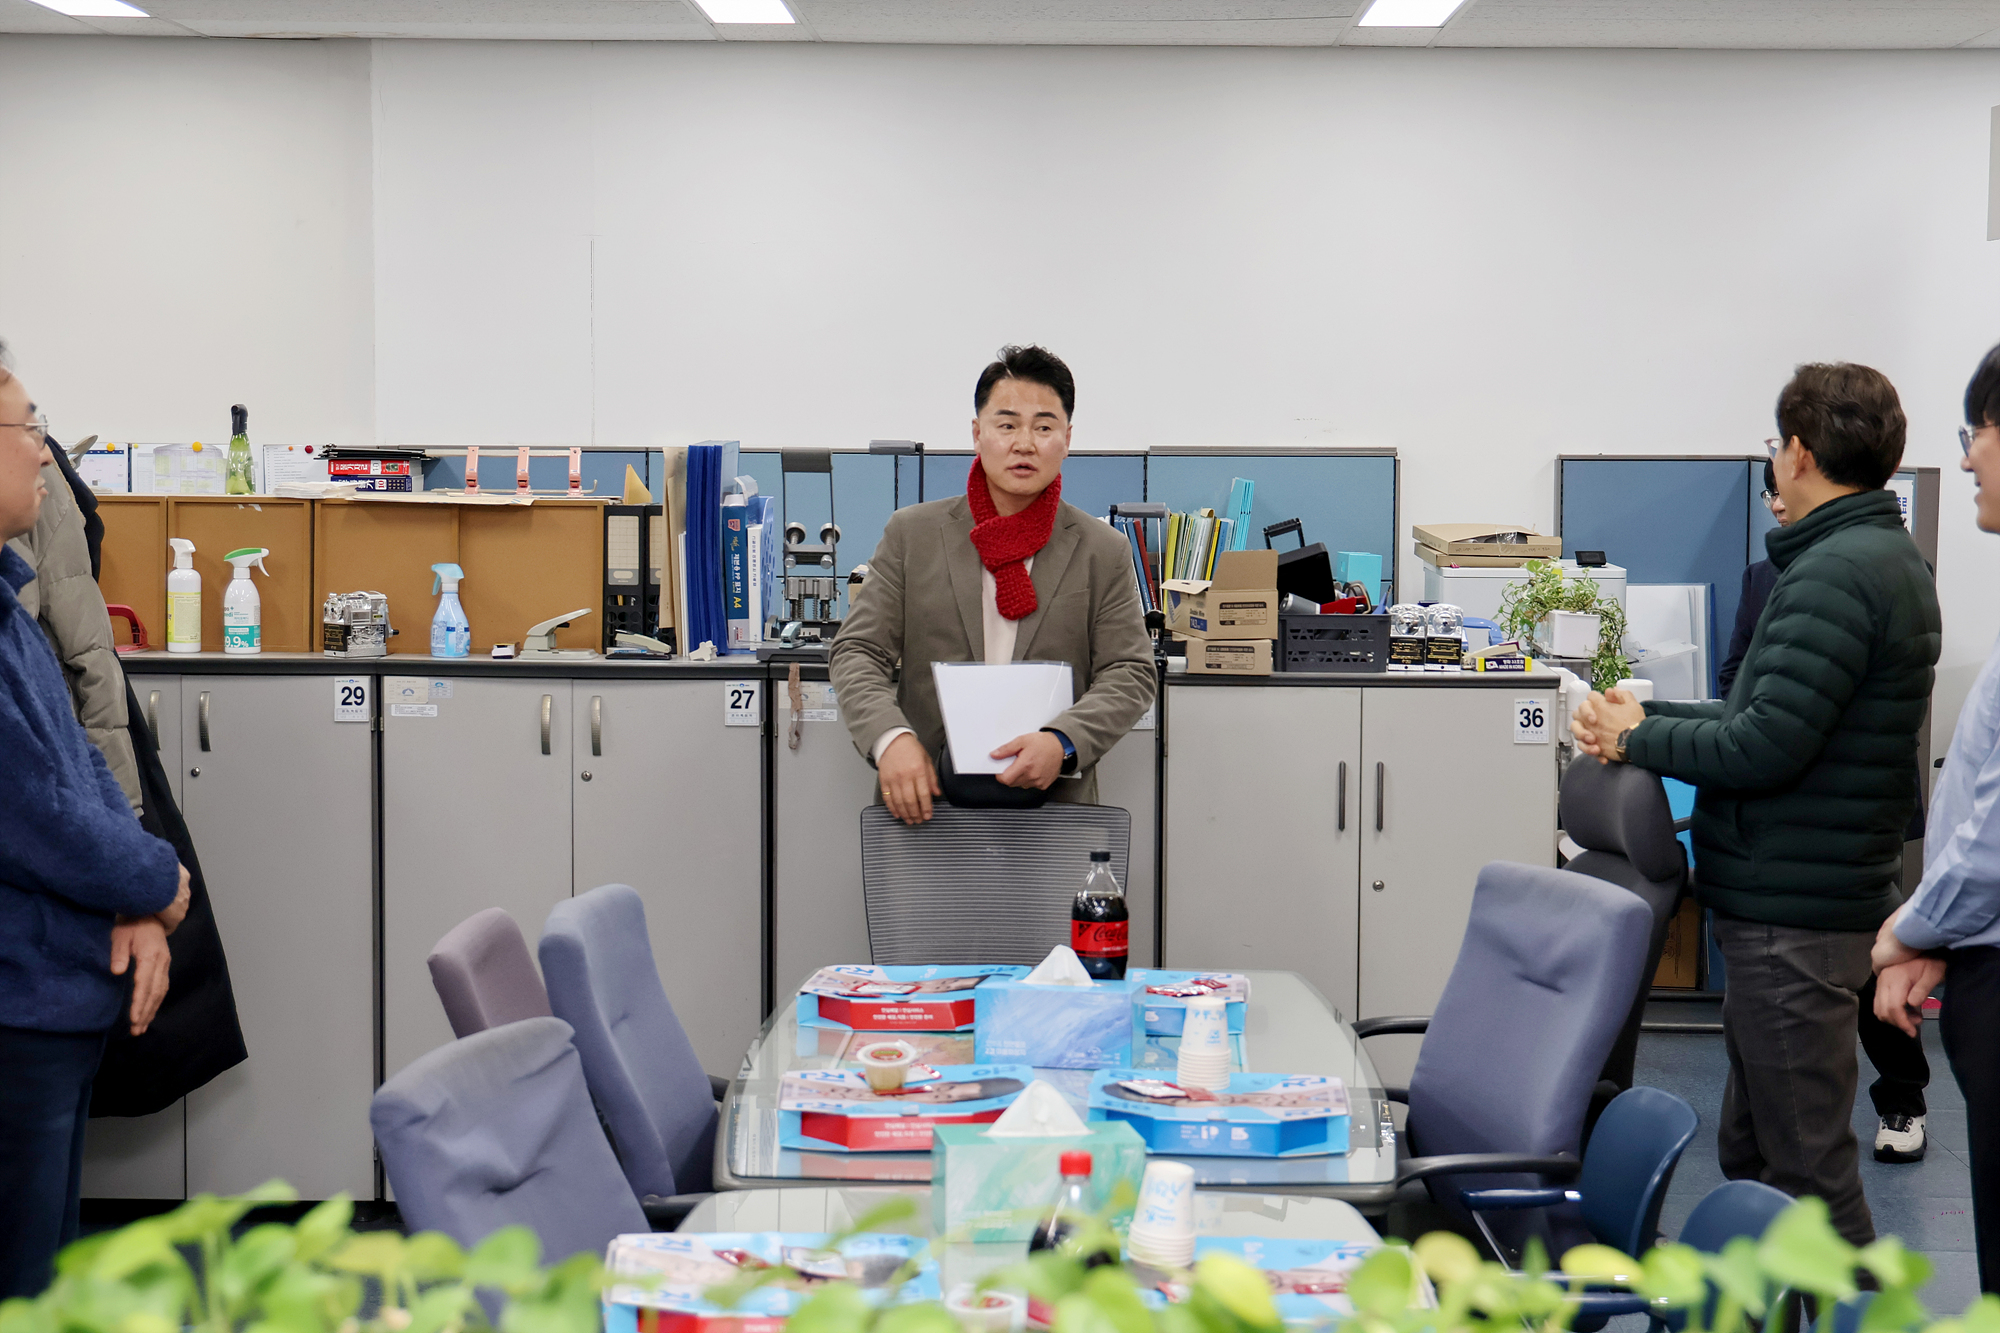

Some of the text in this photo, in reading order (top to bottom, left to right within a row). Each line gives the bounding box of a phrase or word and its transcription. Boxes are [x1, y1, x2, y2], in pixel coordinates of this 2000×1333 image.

[378, 480, 385, 488] 10
[733, 596, 742, 609] A4
[341, 686, 365, 706] 29
[730, 689, 755, 709] 27
[1519, 708, 1544, 728] 36
